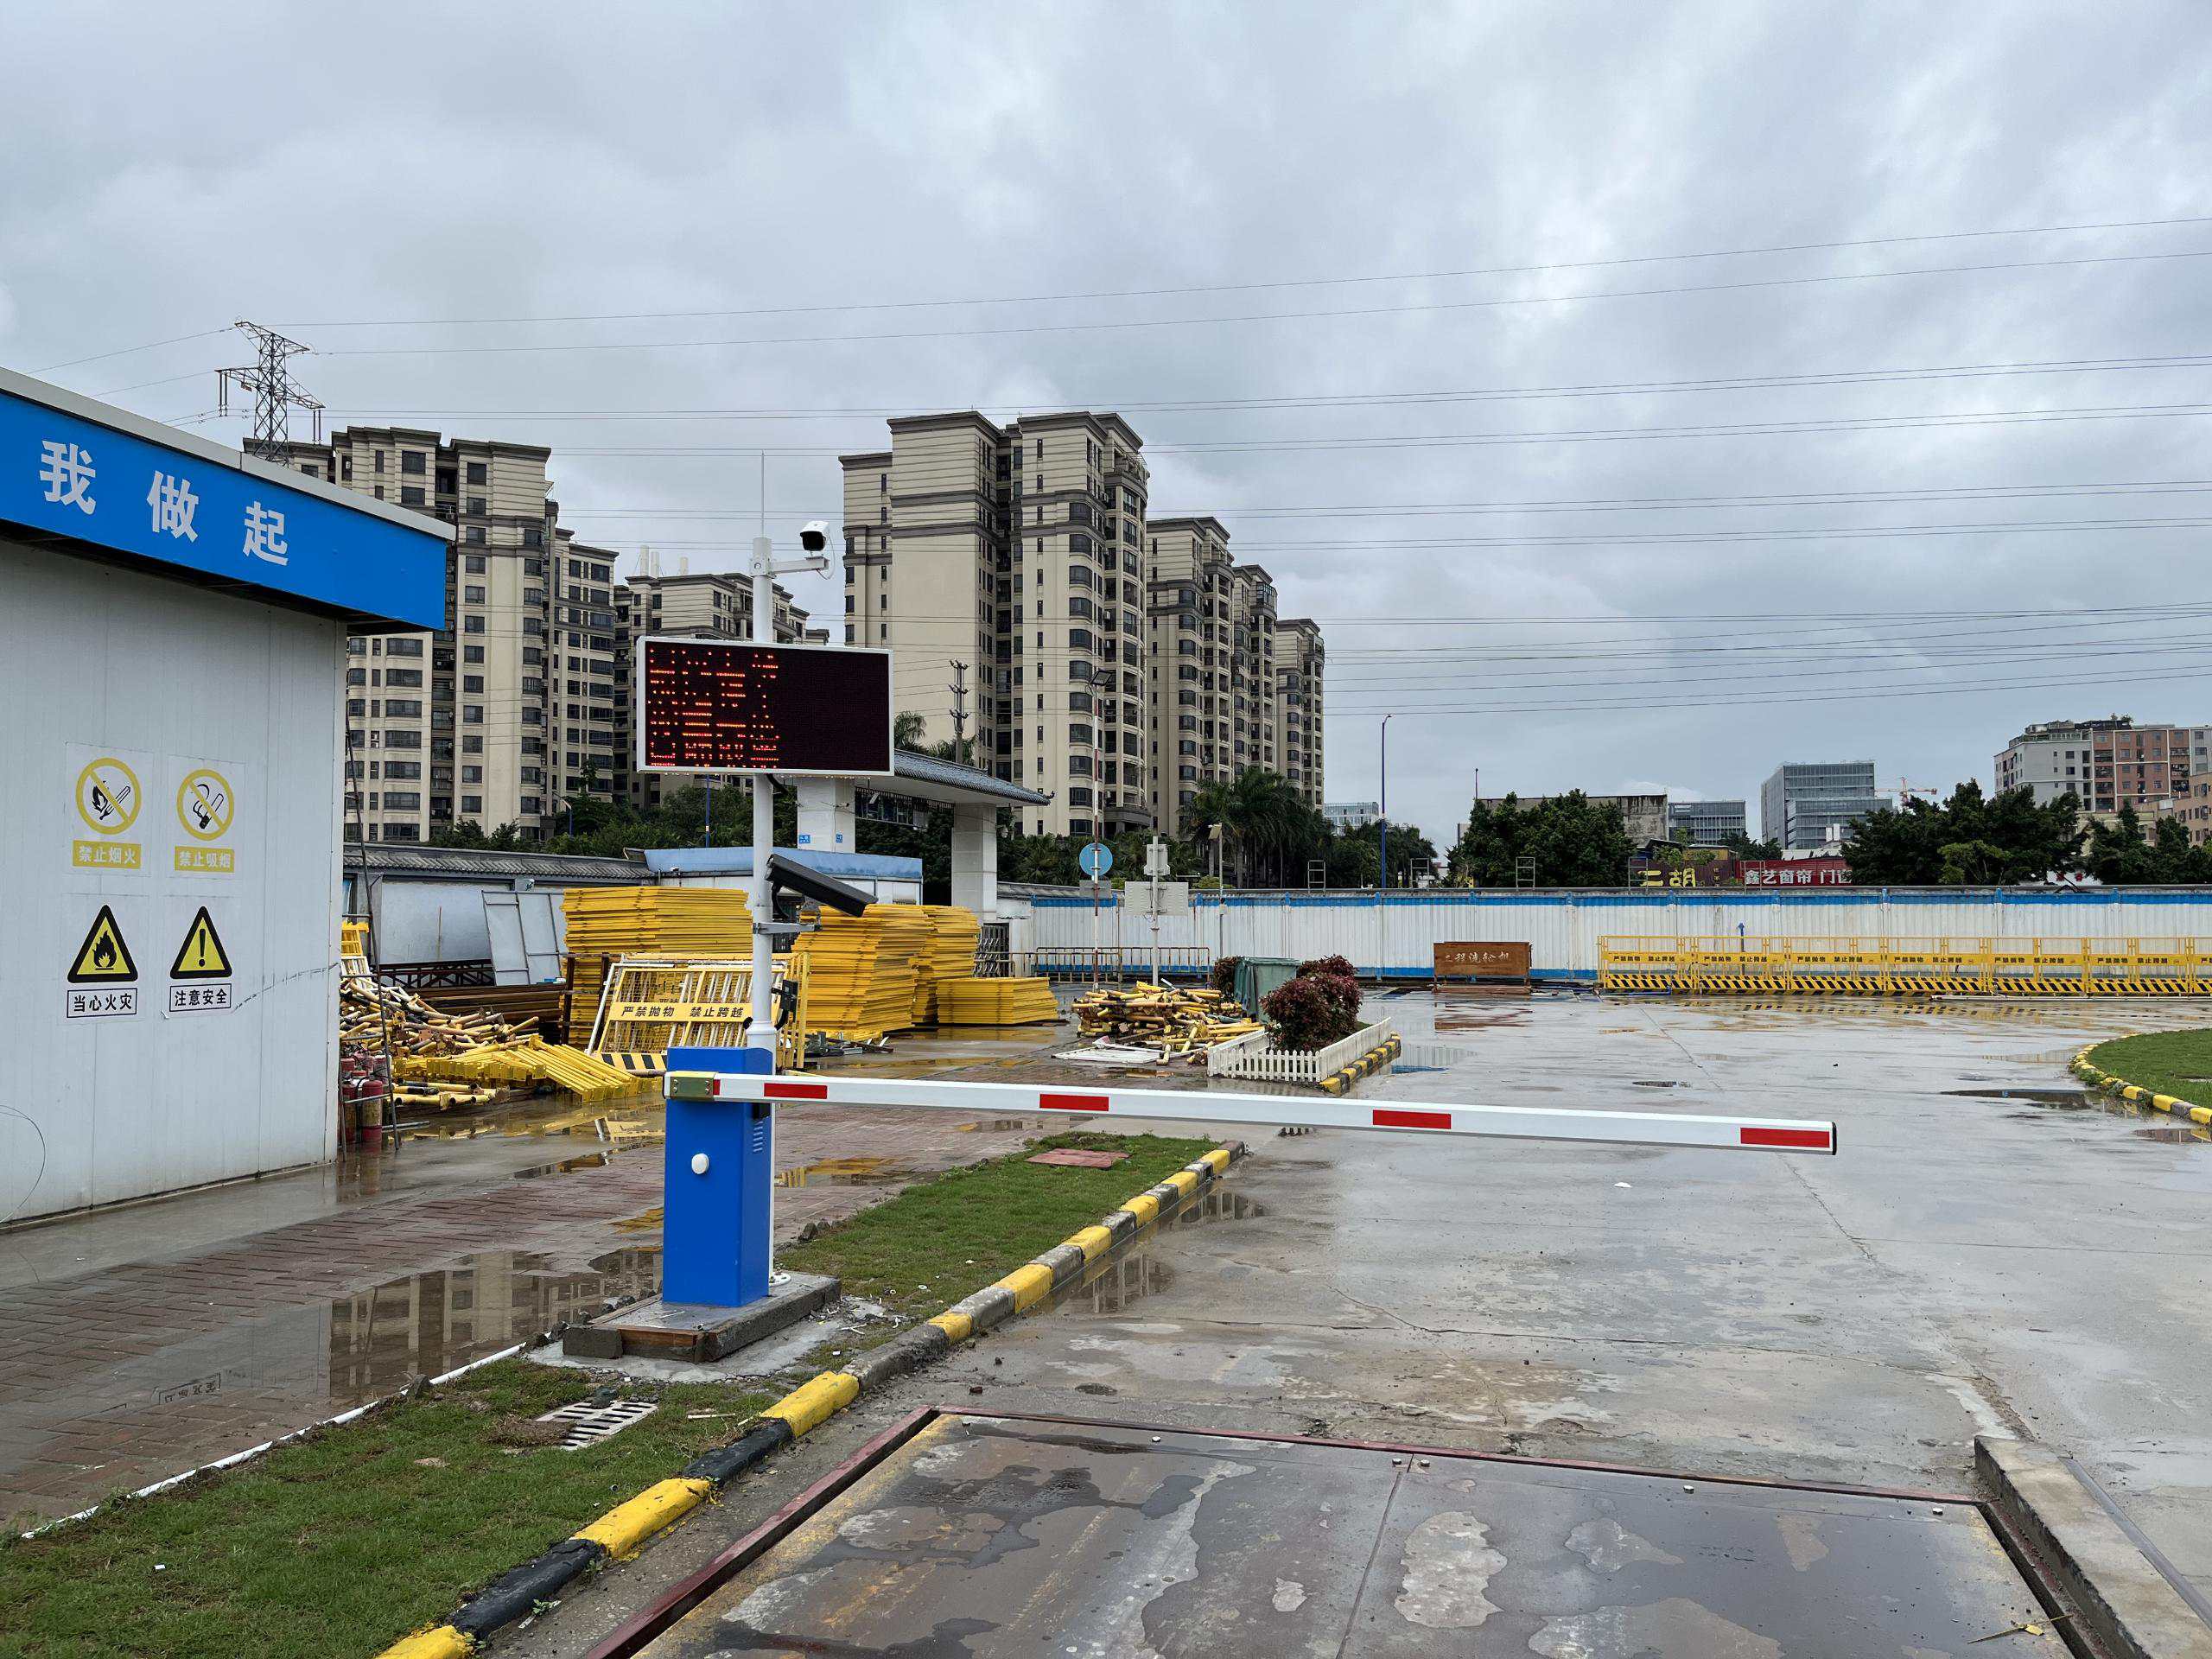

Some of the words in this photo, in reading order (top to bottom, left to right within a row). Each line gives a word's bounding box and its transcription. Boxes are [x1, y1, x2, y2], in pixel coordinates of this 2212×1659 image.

[79, 846, 137, 864] 禁止烟火
[179, 850, 231, 868] 禁止吸烟
[73, 993, 132, 1013] 当心火灾
[175, 988, 227, 1007] 注意安全
[621, 1006, 675, 1017] 严禁抛物
[690, 1006, 744, 1018] 禁止跨越
